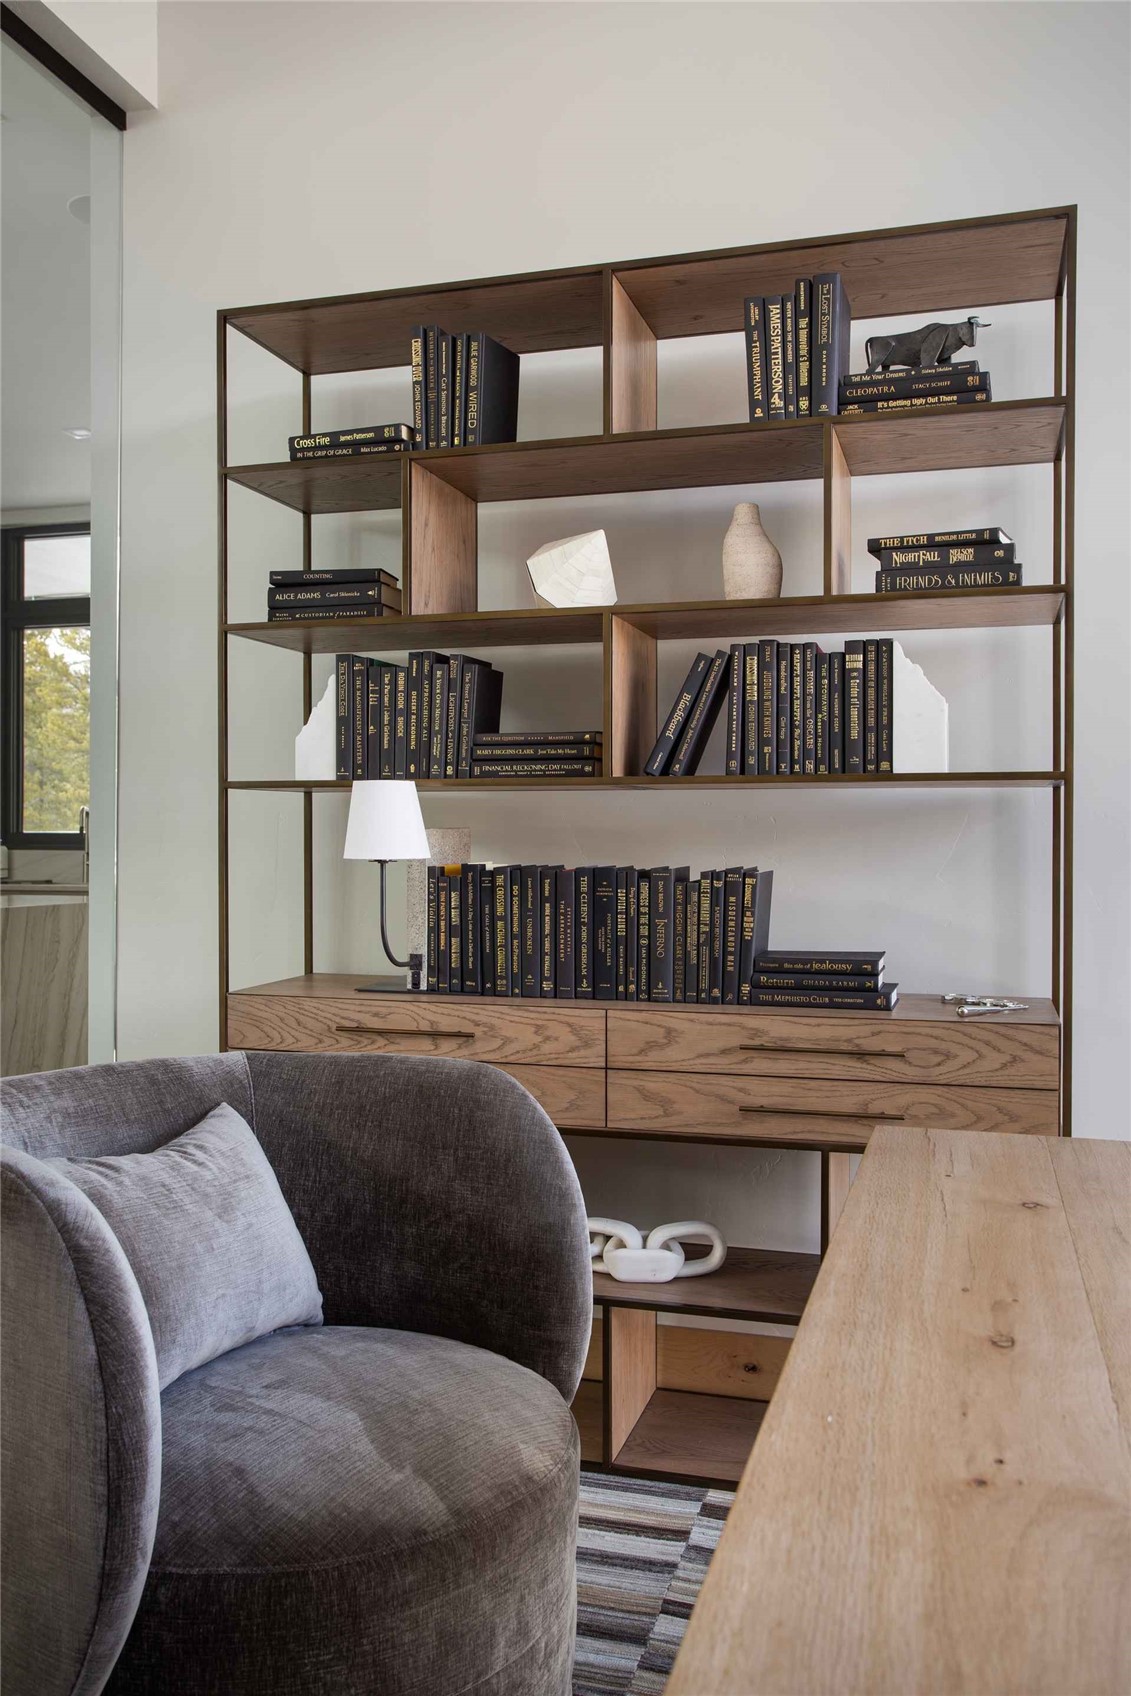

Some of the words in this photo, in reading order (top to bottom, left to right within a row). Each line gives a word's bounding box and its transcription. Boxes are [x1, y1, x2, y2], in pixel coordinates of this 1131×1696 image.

[799, 318, 809, 329] The
[470, 358, 478, 386] GARWOOD
[752, 342, 762, 400] TRIUMPHANT
[800, 362, 810, 386] Dilemma
[847, 386, 896, 398] CLEOPATRA
[889, 399, 911, 408] Getting
[912, 397, 926, 406] Ugly
[468, 391, 478, 429] WIRED
[294, 438, 315, 448] Cross
[316, 436, 330, 446] Fire
[880, 538, 900, 548] THE
[904, 536, 928, 546] ITCH
[896, 576, 942, 590] FRIENDS
[945, 575, 957, 586] &
[959, 572, 1003, 585] ENEMIES
[764, 670, 772, 700] JUGGLING
[850, 680, 860, 697] Garden
[665, 692, 692, 740] Blackbeard
[496, 887, 505, 916] CROSSING
[618, 889, 626, 912] CAPITAL
[618, 914, 626, 936] GAINES
[640, 914, 649, 926] THE
[728, 896, 736, 952] MISDEMEANOR
[497, 920, 506, 946] MICHAEL
[656, 919, 668, 958] INFERNO
[811, 960, 852, 972] jealousy
[760, 976, 795, 986] Return
